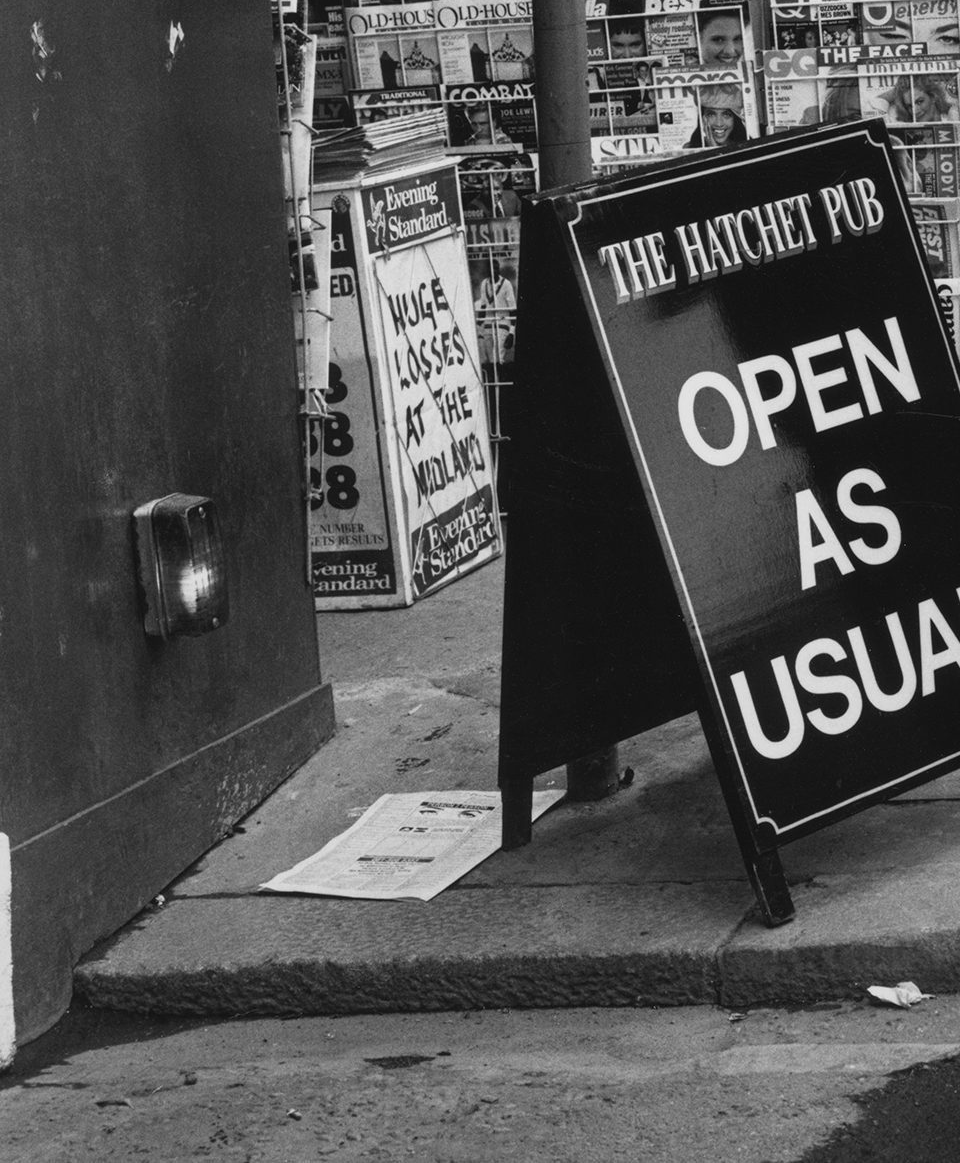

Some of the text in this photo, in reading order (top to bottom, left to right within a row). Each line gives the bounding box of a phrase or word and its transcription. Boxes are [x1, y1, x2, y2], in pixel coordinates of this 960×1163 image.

[821, 44, 925, 64] THE FACE
[380, 90, 427, 101] TRADITIONAL
[450, 82, 534, 107] COMBAT
[500, 108, 514, 117] JOE
[938, 129, 955, 194] MLODY
[384, 179, 438, 212] Evening
[388, 202, 449, 241] Standard
[598, 177, 885, 305] THE HATCHET PUB
[388, 277, 449, 338] HUGE
[395, 326, 466, 391] LOSSES
[433, 386, 473, 425] THE
[677, 316, 922, 468] OPEN
[406, 398, 426, 450] AT
[319, 522, 365, 536] NUMBER
[339, 533, 385, 546] RESULTS
[427, 497, 486, 552] Evening
[794, 467, 902, 591] AS
